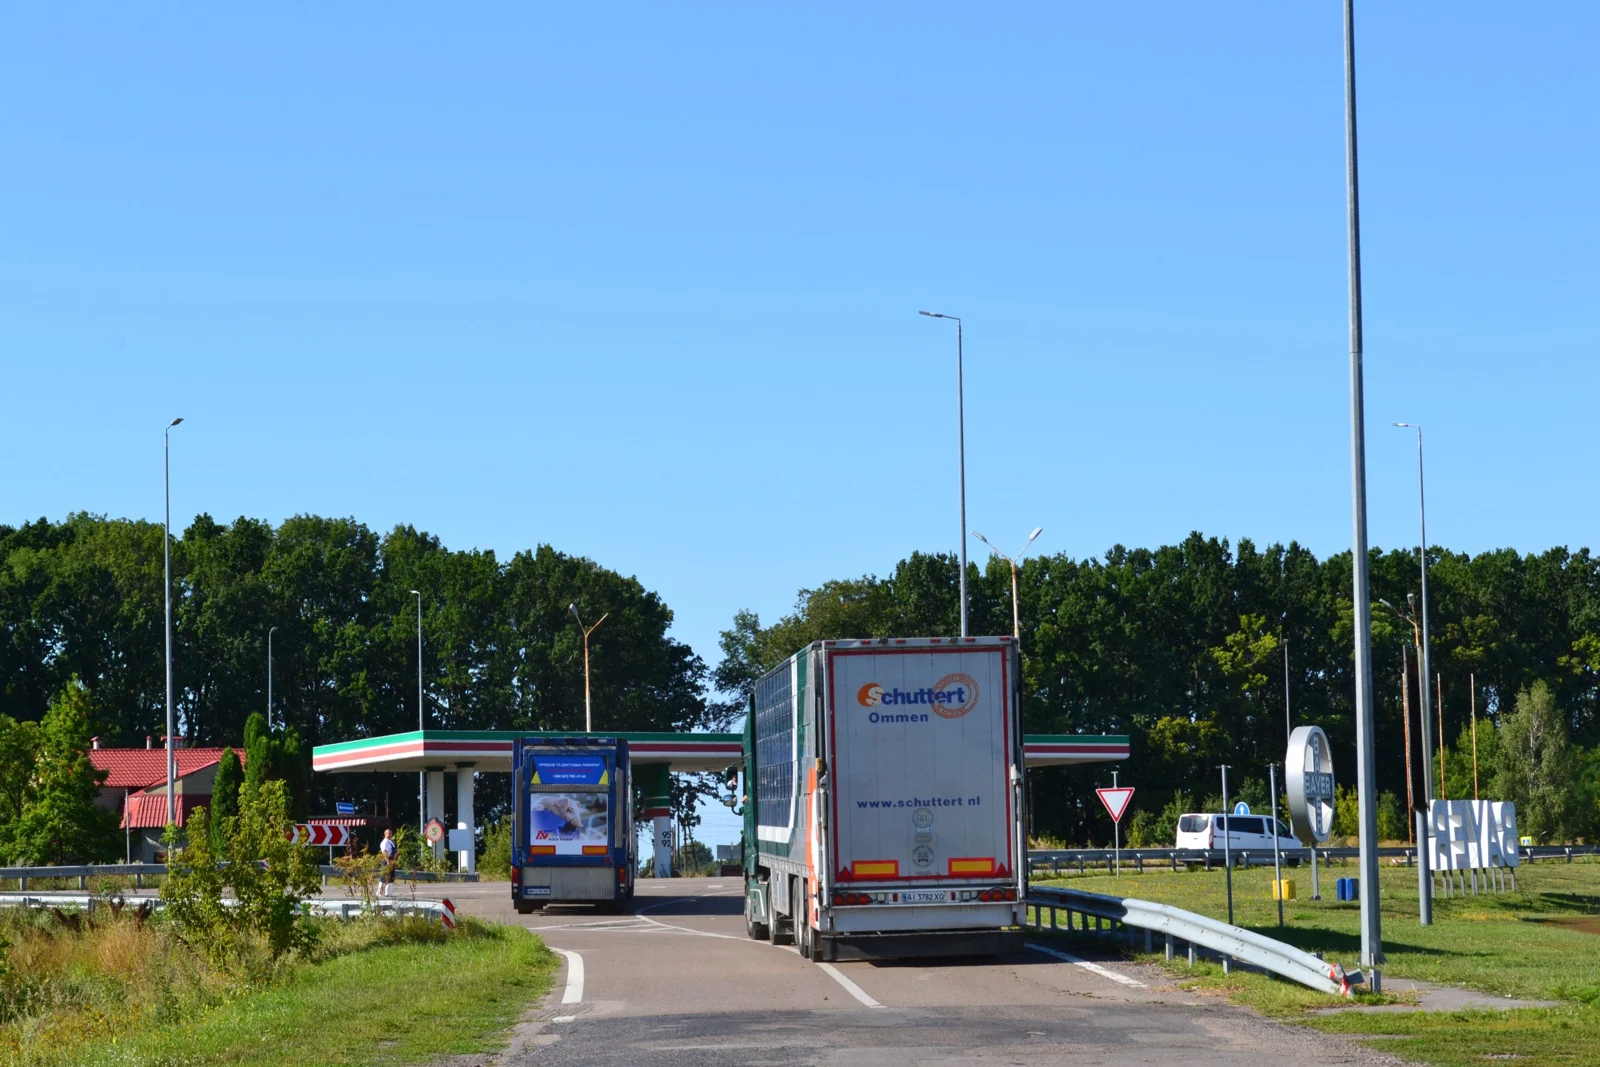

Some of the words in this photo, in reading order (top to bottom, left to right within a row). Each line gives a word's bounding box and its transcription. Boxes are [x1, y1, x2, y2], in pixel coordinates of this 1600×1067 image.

[863, 685, 965, 706] Schuttert
[868, 712, 929, 723] Ommen
[1304, 776, 1331, 795] BAYER
[431, 827, 437, 836] 5
[661, 839, 671, 847] 92
